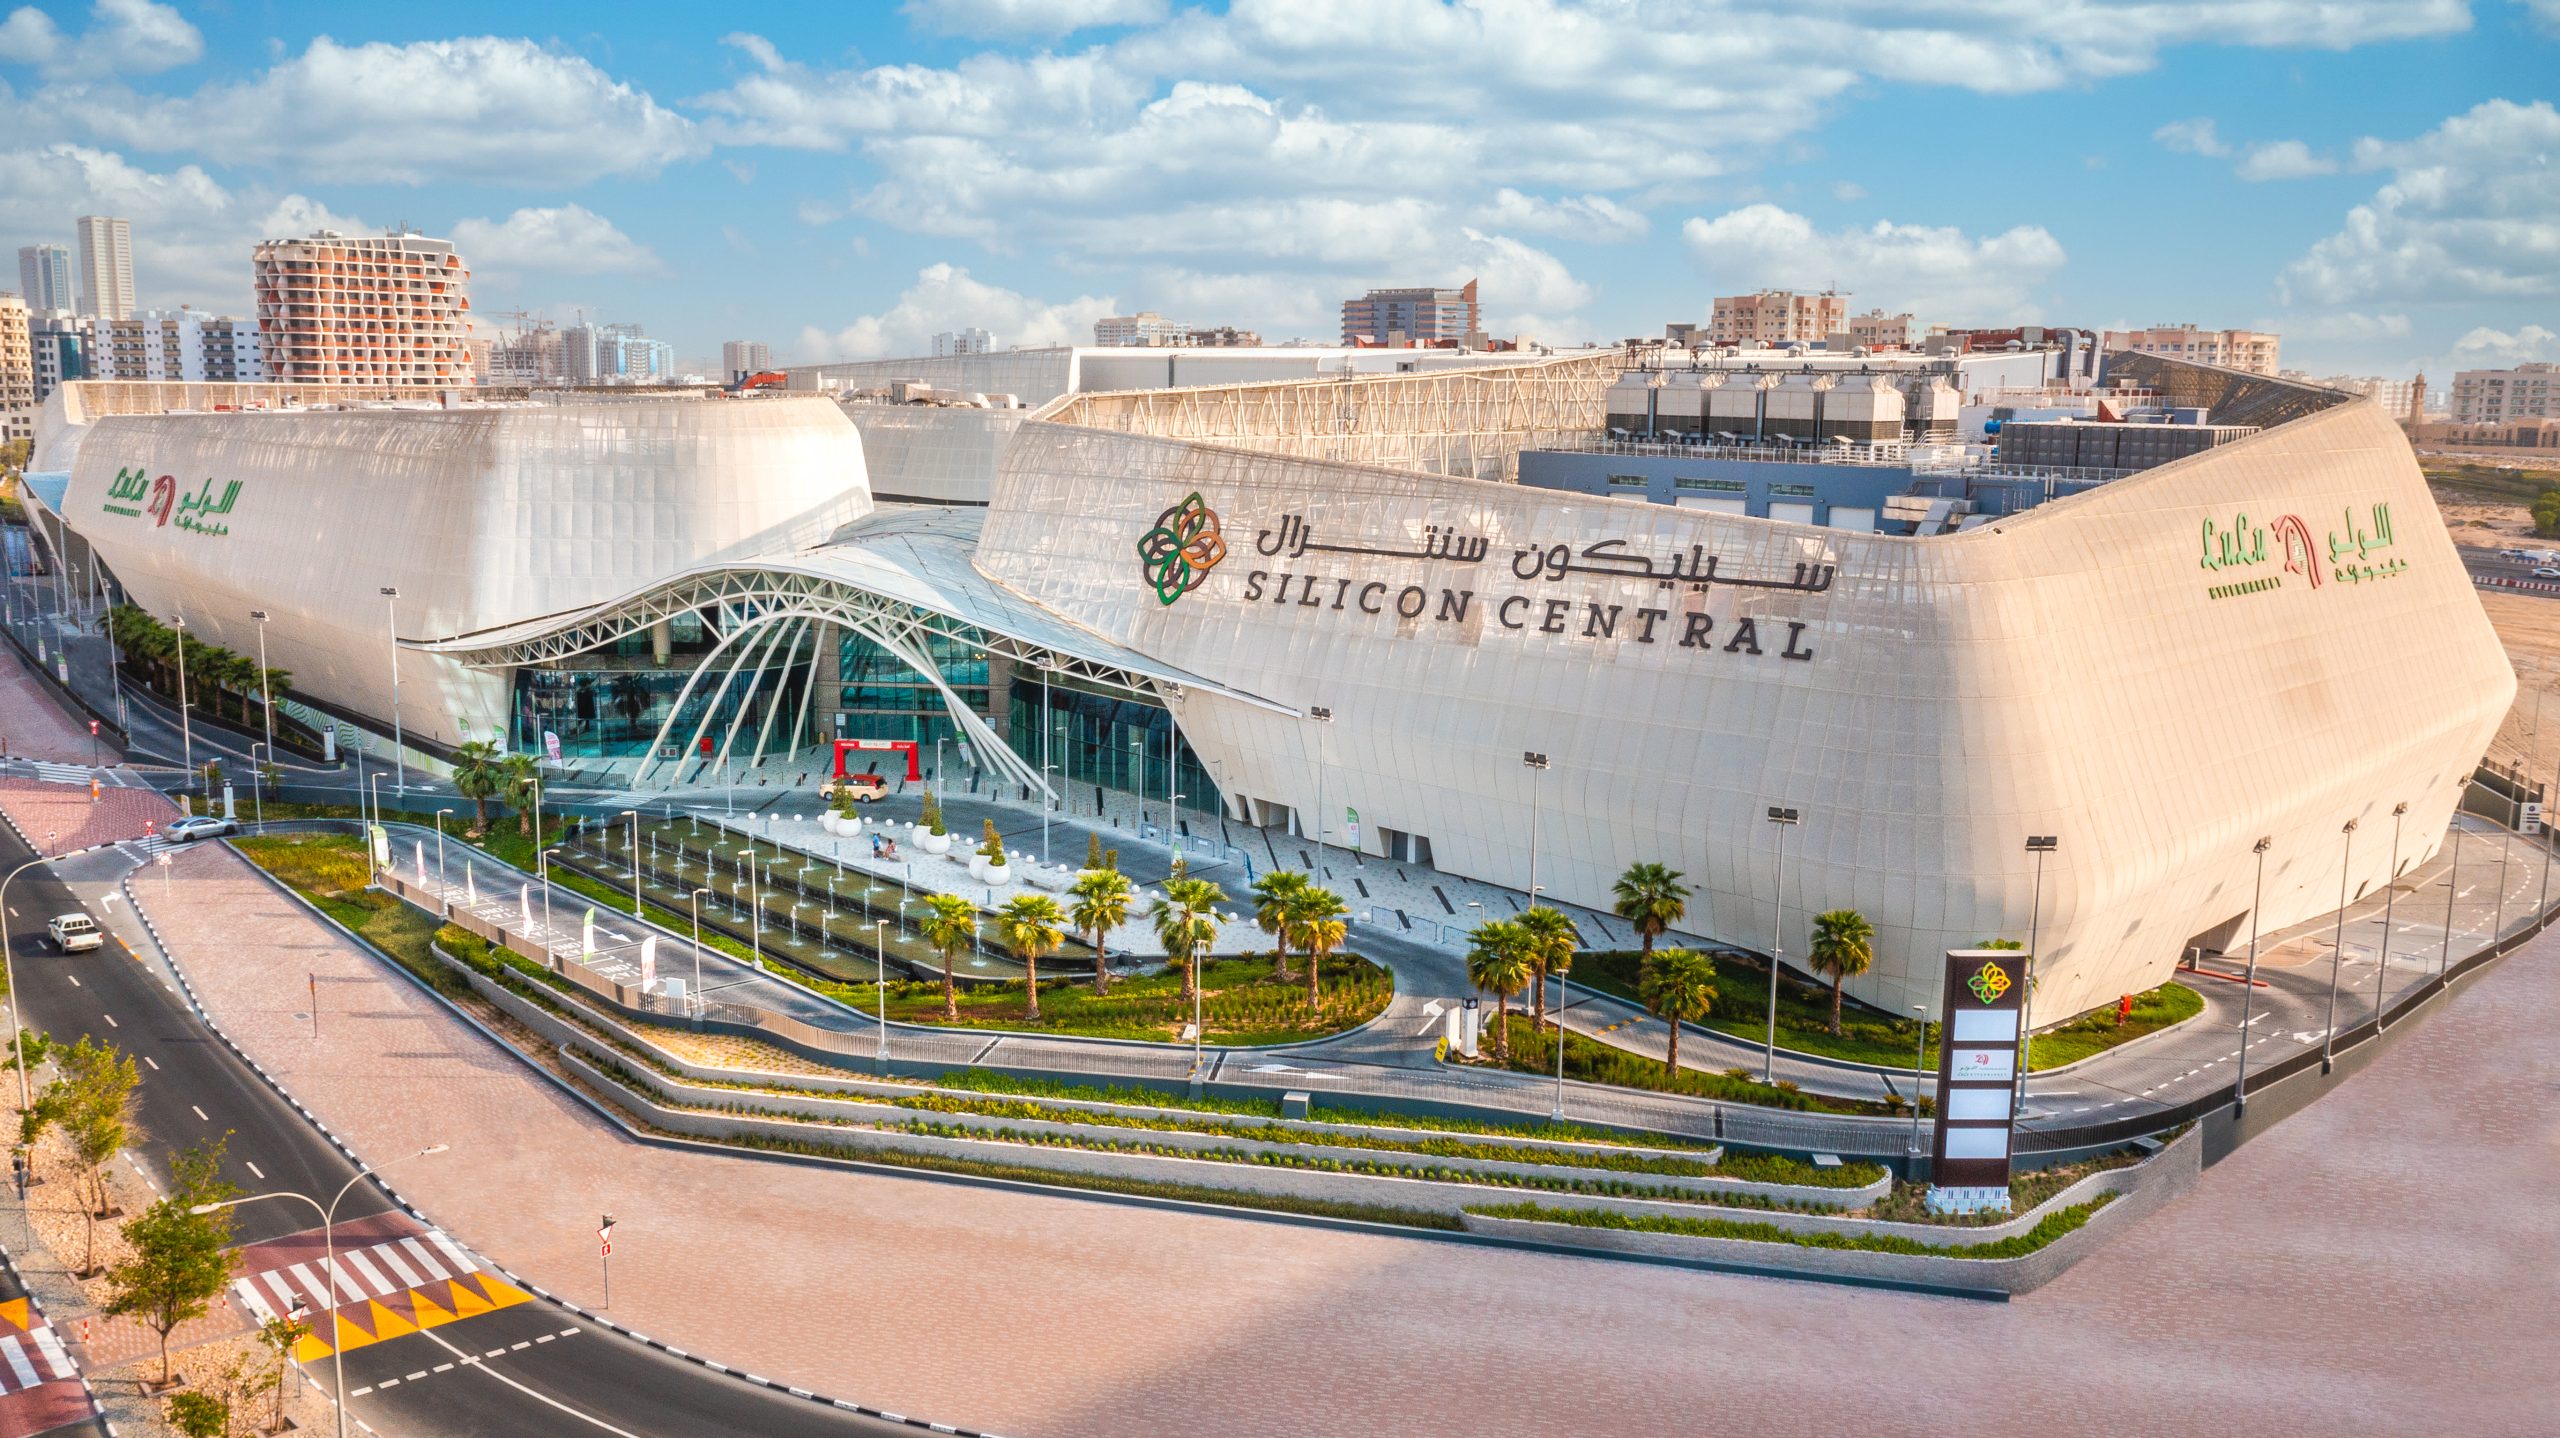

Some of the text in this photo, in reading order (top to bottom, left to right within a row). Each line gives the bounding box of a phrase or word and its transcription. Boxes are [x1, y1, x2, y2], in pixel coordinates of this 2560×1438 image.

[1256, 514, 1835, 592] سيليكون سنترال
[1244, 570, 1813, 661] SILICON CENTRAL
